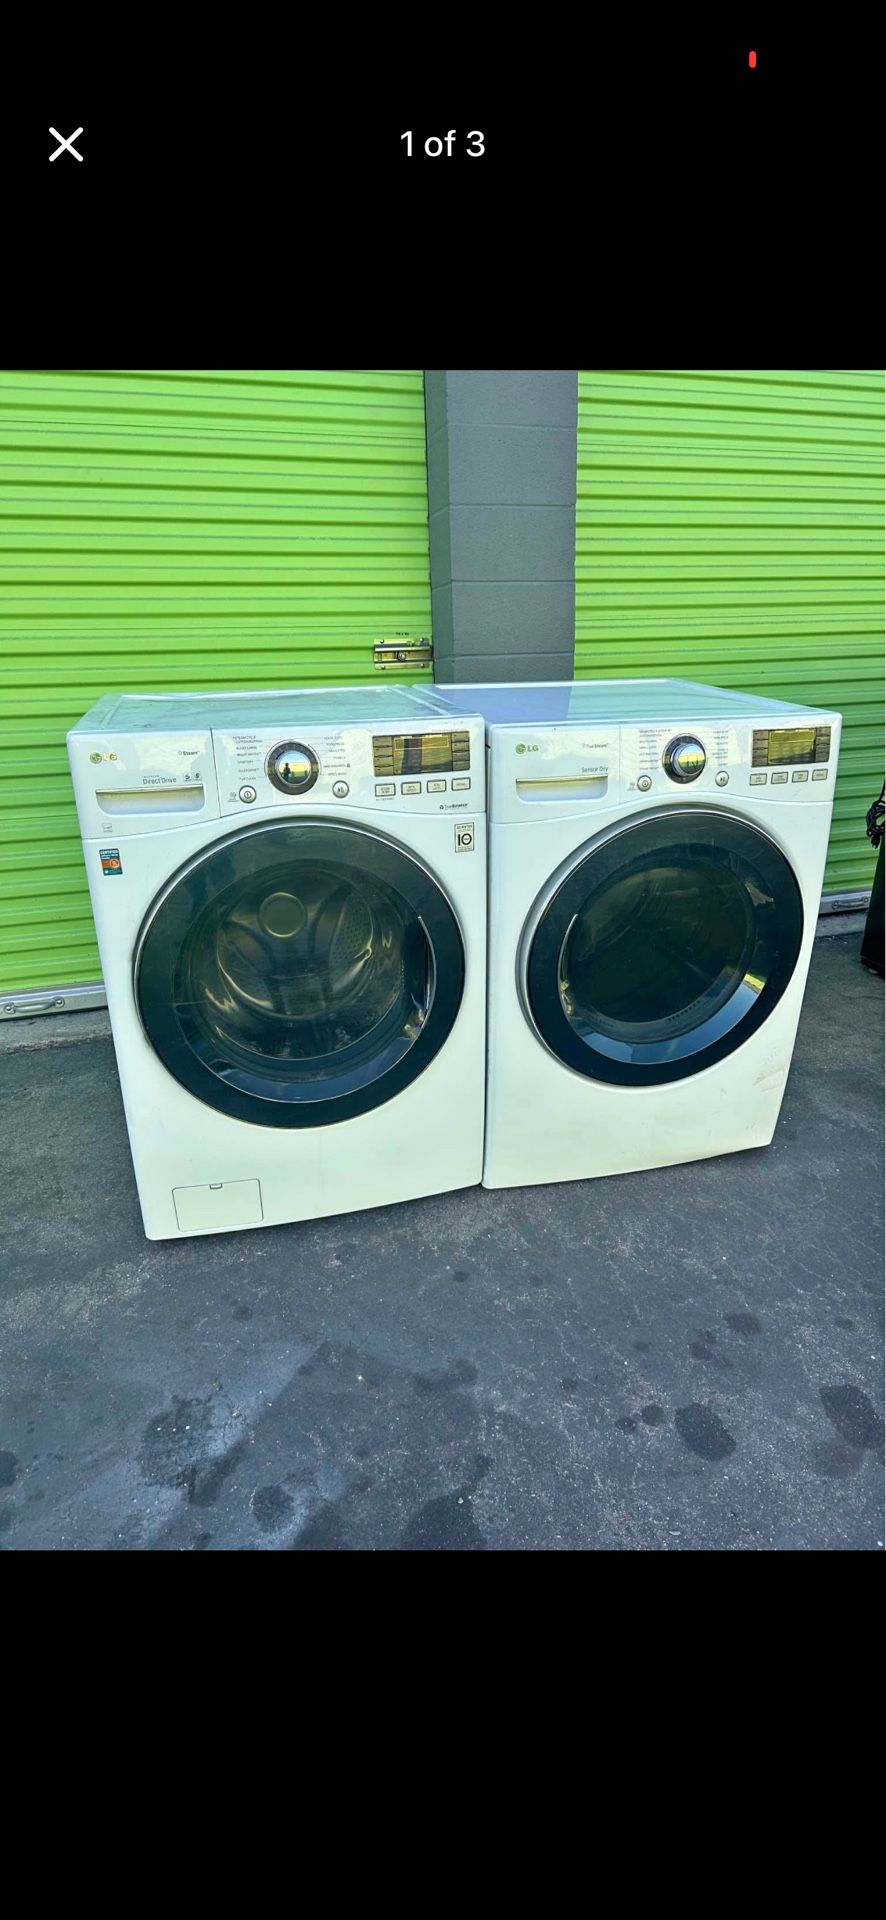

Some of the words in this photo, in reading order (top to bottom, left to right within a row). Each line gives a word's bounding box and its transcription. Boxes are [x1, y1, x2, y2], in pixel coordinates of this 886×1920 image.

[527, 744, 540, 753] LG
[581, 766, 599, 774] Sensor
[599, 765, 609, 774] Dry
[142, 777, 161, 785] Direct
[161, 776, 177, 784] Drive
